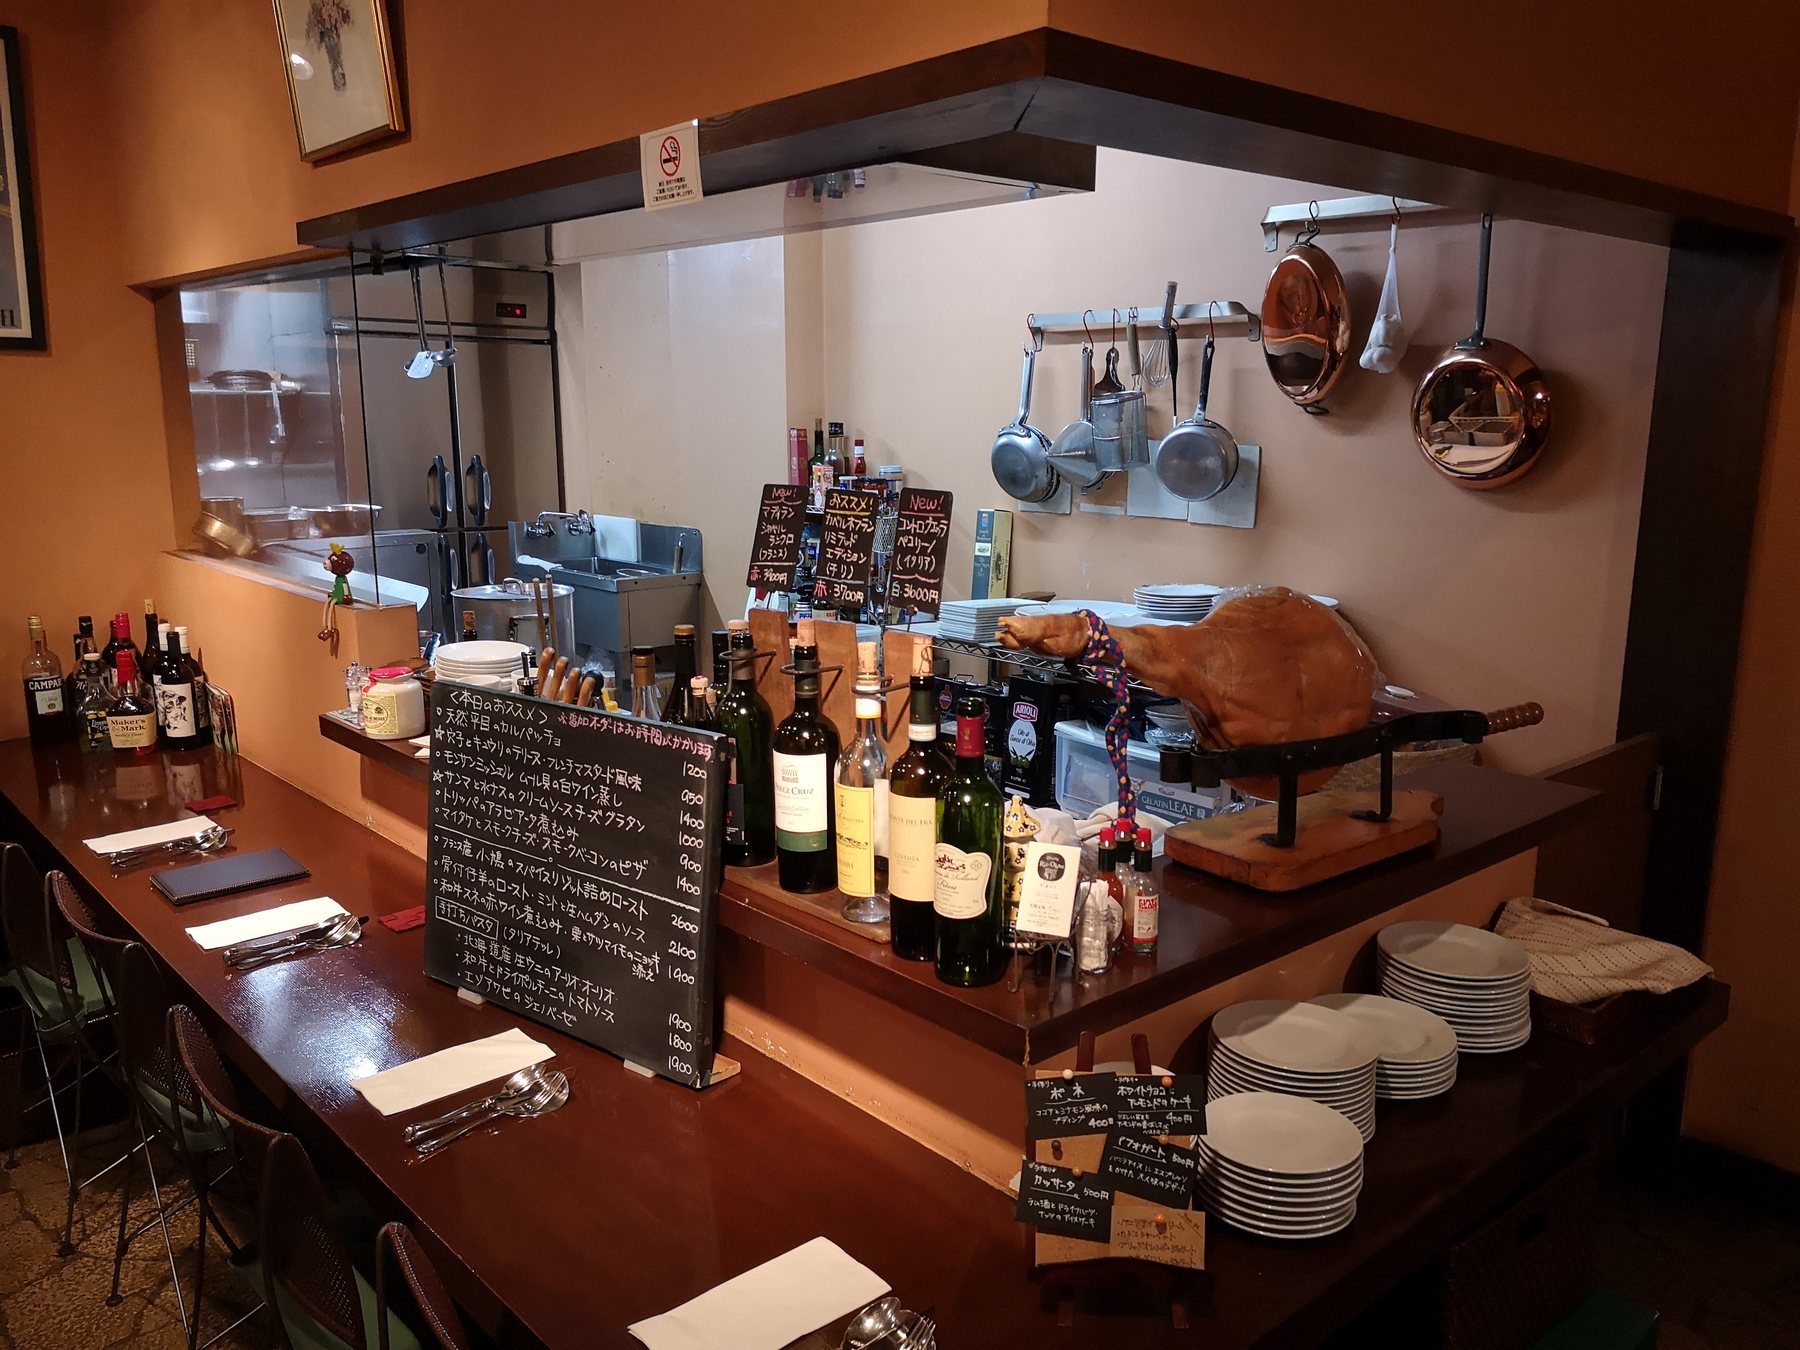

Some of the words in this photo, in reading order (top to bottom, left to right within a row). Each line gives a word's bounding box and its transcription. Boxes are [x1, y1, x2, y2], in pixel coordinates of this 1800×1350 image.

[910, 494, 945, 511] New!
[825, 515, 874, 533] カベルネフラン
[769, 533, 794, 546] ランクロ
[825, 532, 859, 547] リミテッド
[897, 535, 936, 554] ペコリーノ
[826, 548, 867, 563] エディション
[1015, 704, 1036, 718] ARIOLI
[682, 761, 708, 779] 1200
[681, 788, 704, 806] 950
[1169, 800, 1194, 816] LEAF
[680, 810, 705, 830] 1400
[679, 831, 704, 849] 1000
[680, 853, 702, 873] 900
[677, 875, 701, 896] 1400
[439, 900, 494, 933] 手打ちパスタ
[671, 914, 698, 934] 2600
[668, 941, 697, 961] 2100
[668, 966, 695, 985] 1900
[668, 1013, 692, 1033] 1900
[668, 1032, 692, 1052] 1800
[668, 1055, 692, 1075] 1900
